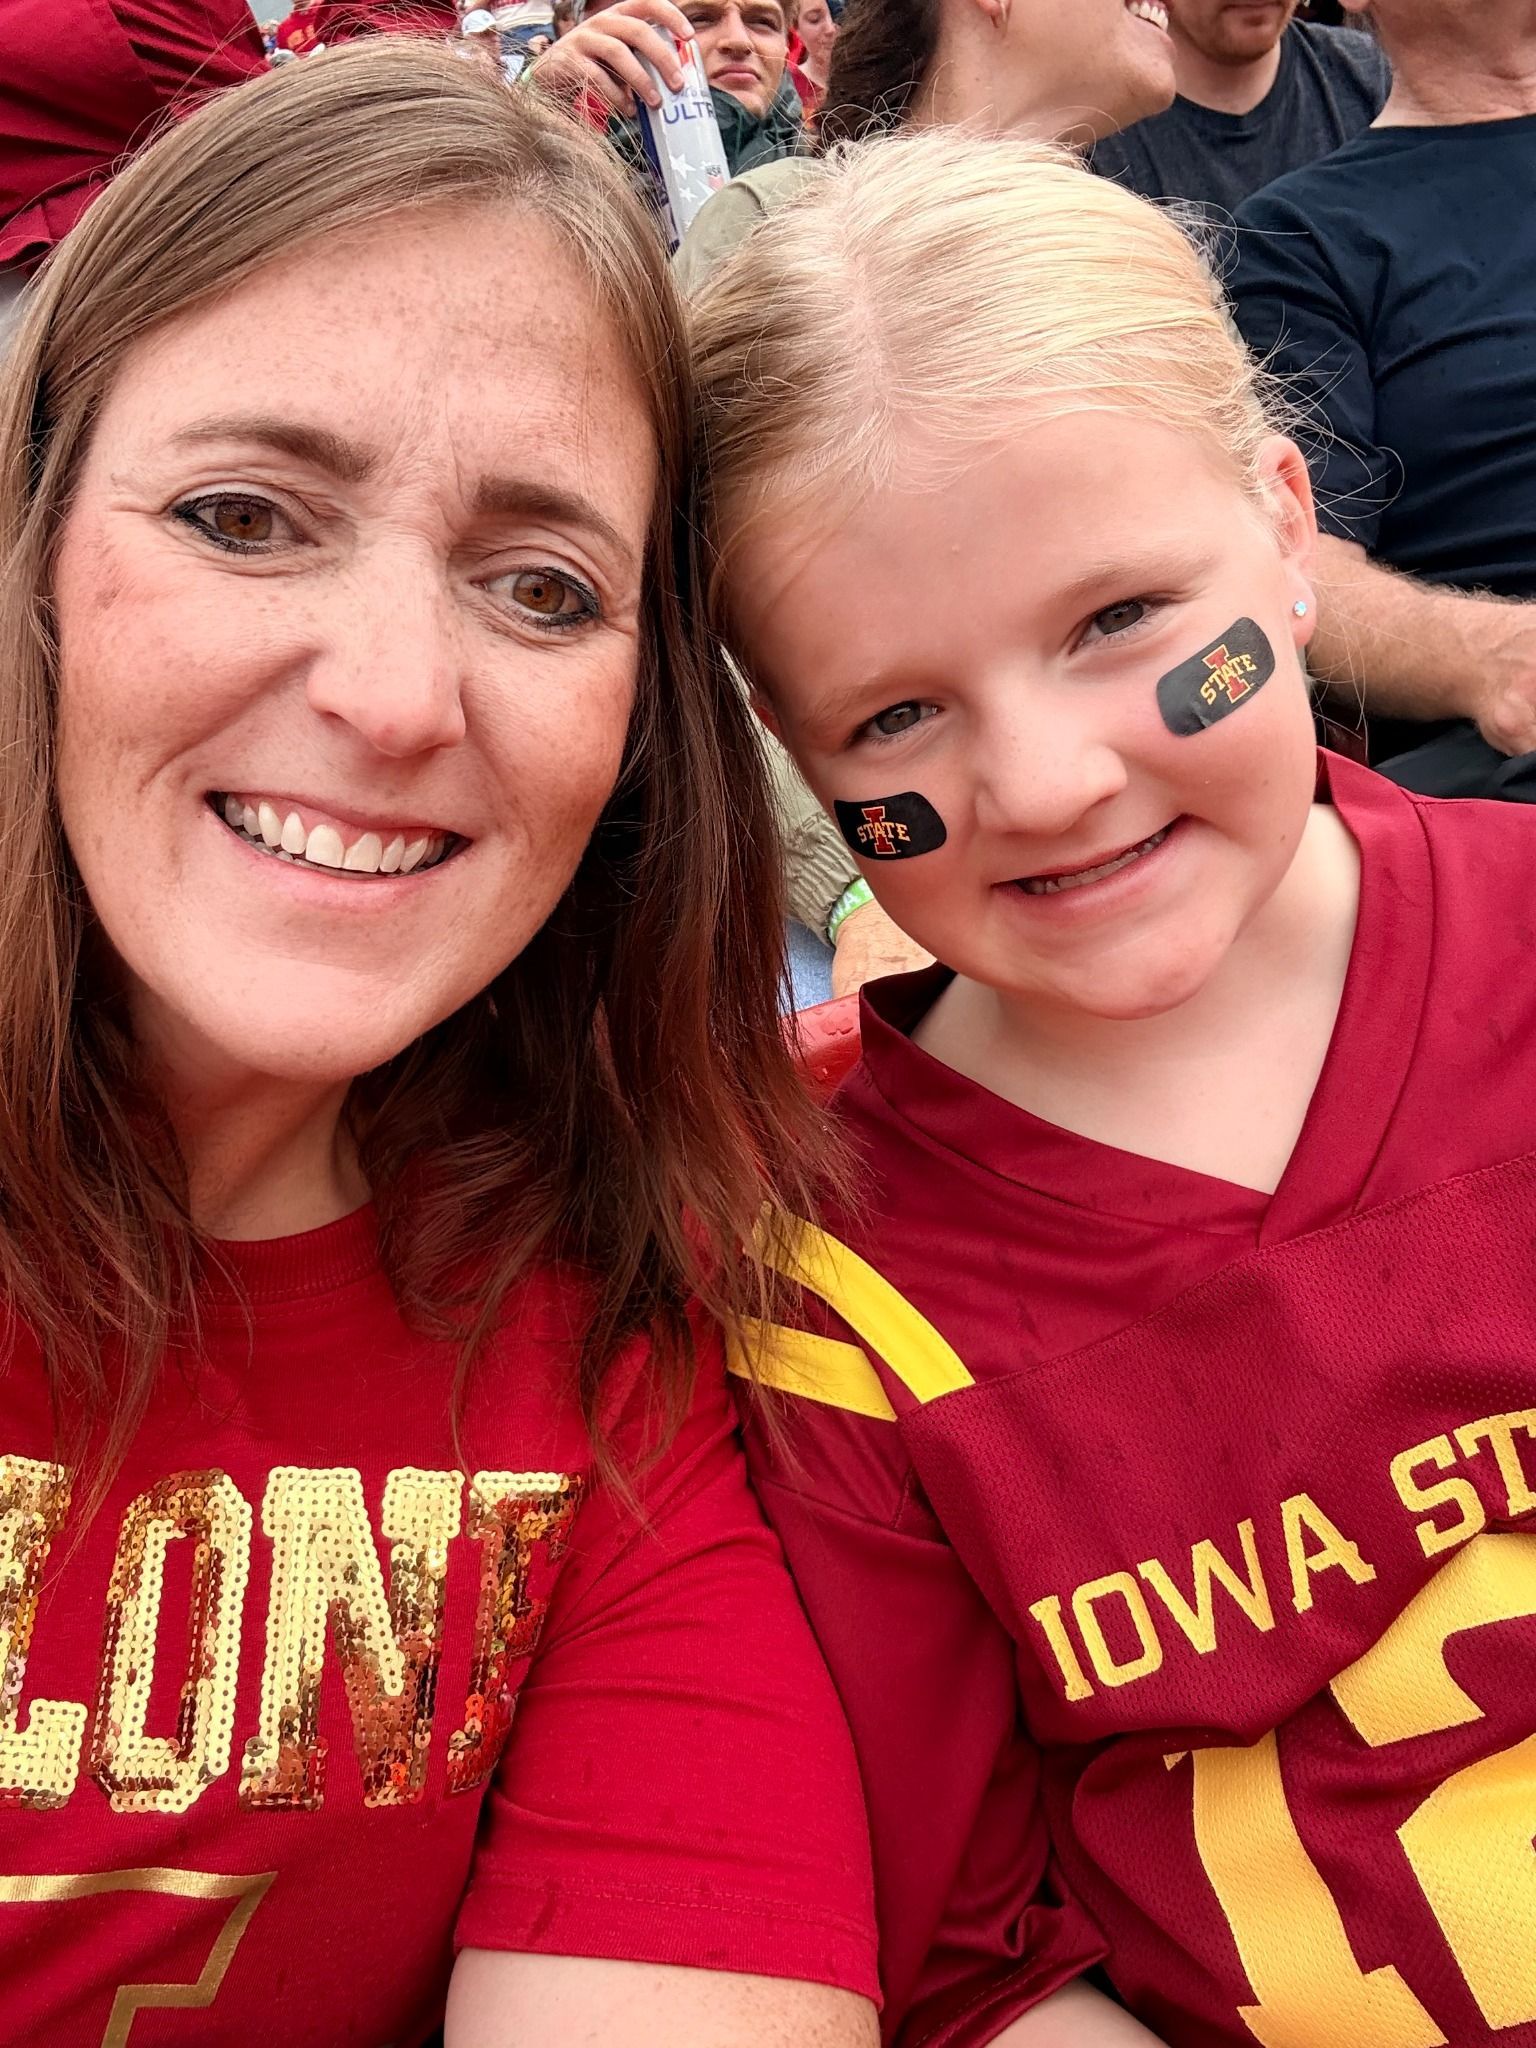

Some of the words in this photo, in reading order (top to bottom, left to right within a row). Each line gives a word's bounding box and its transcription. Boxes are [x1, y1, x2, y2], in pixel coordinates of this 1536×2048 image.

[1200, 653, 1258, 706] STATE
[856, 821, 912, 843] STATE
[1028, 1492, 1379, 1702] IOWA
